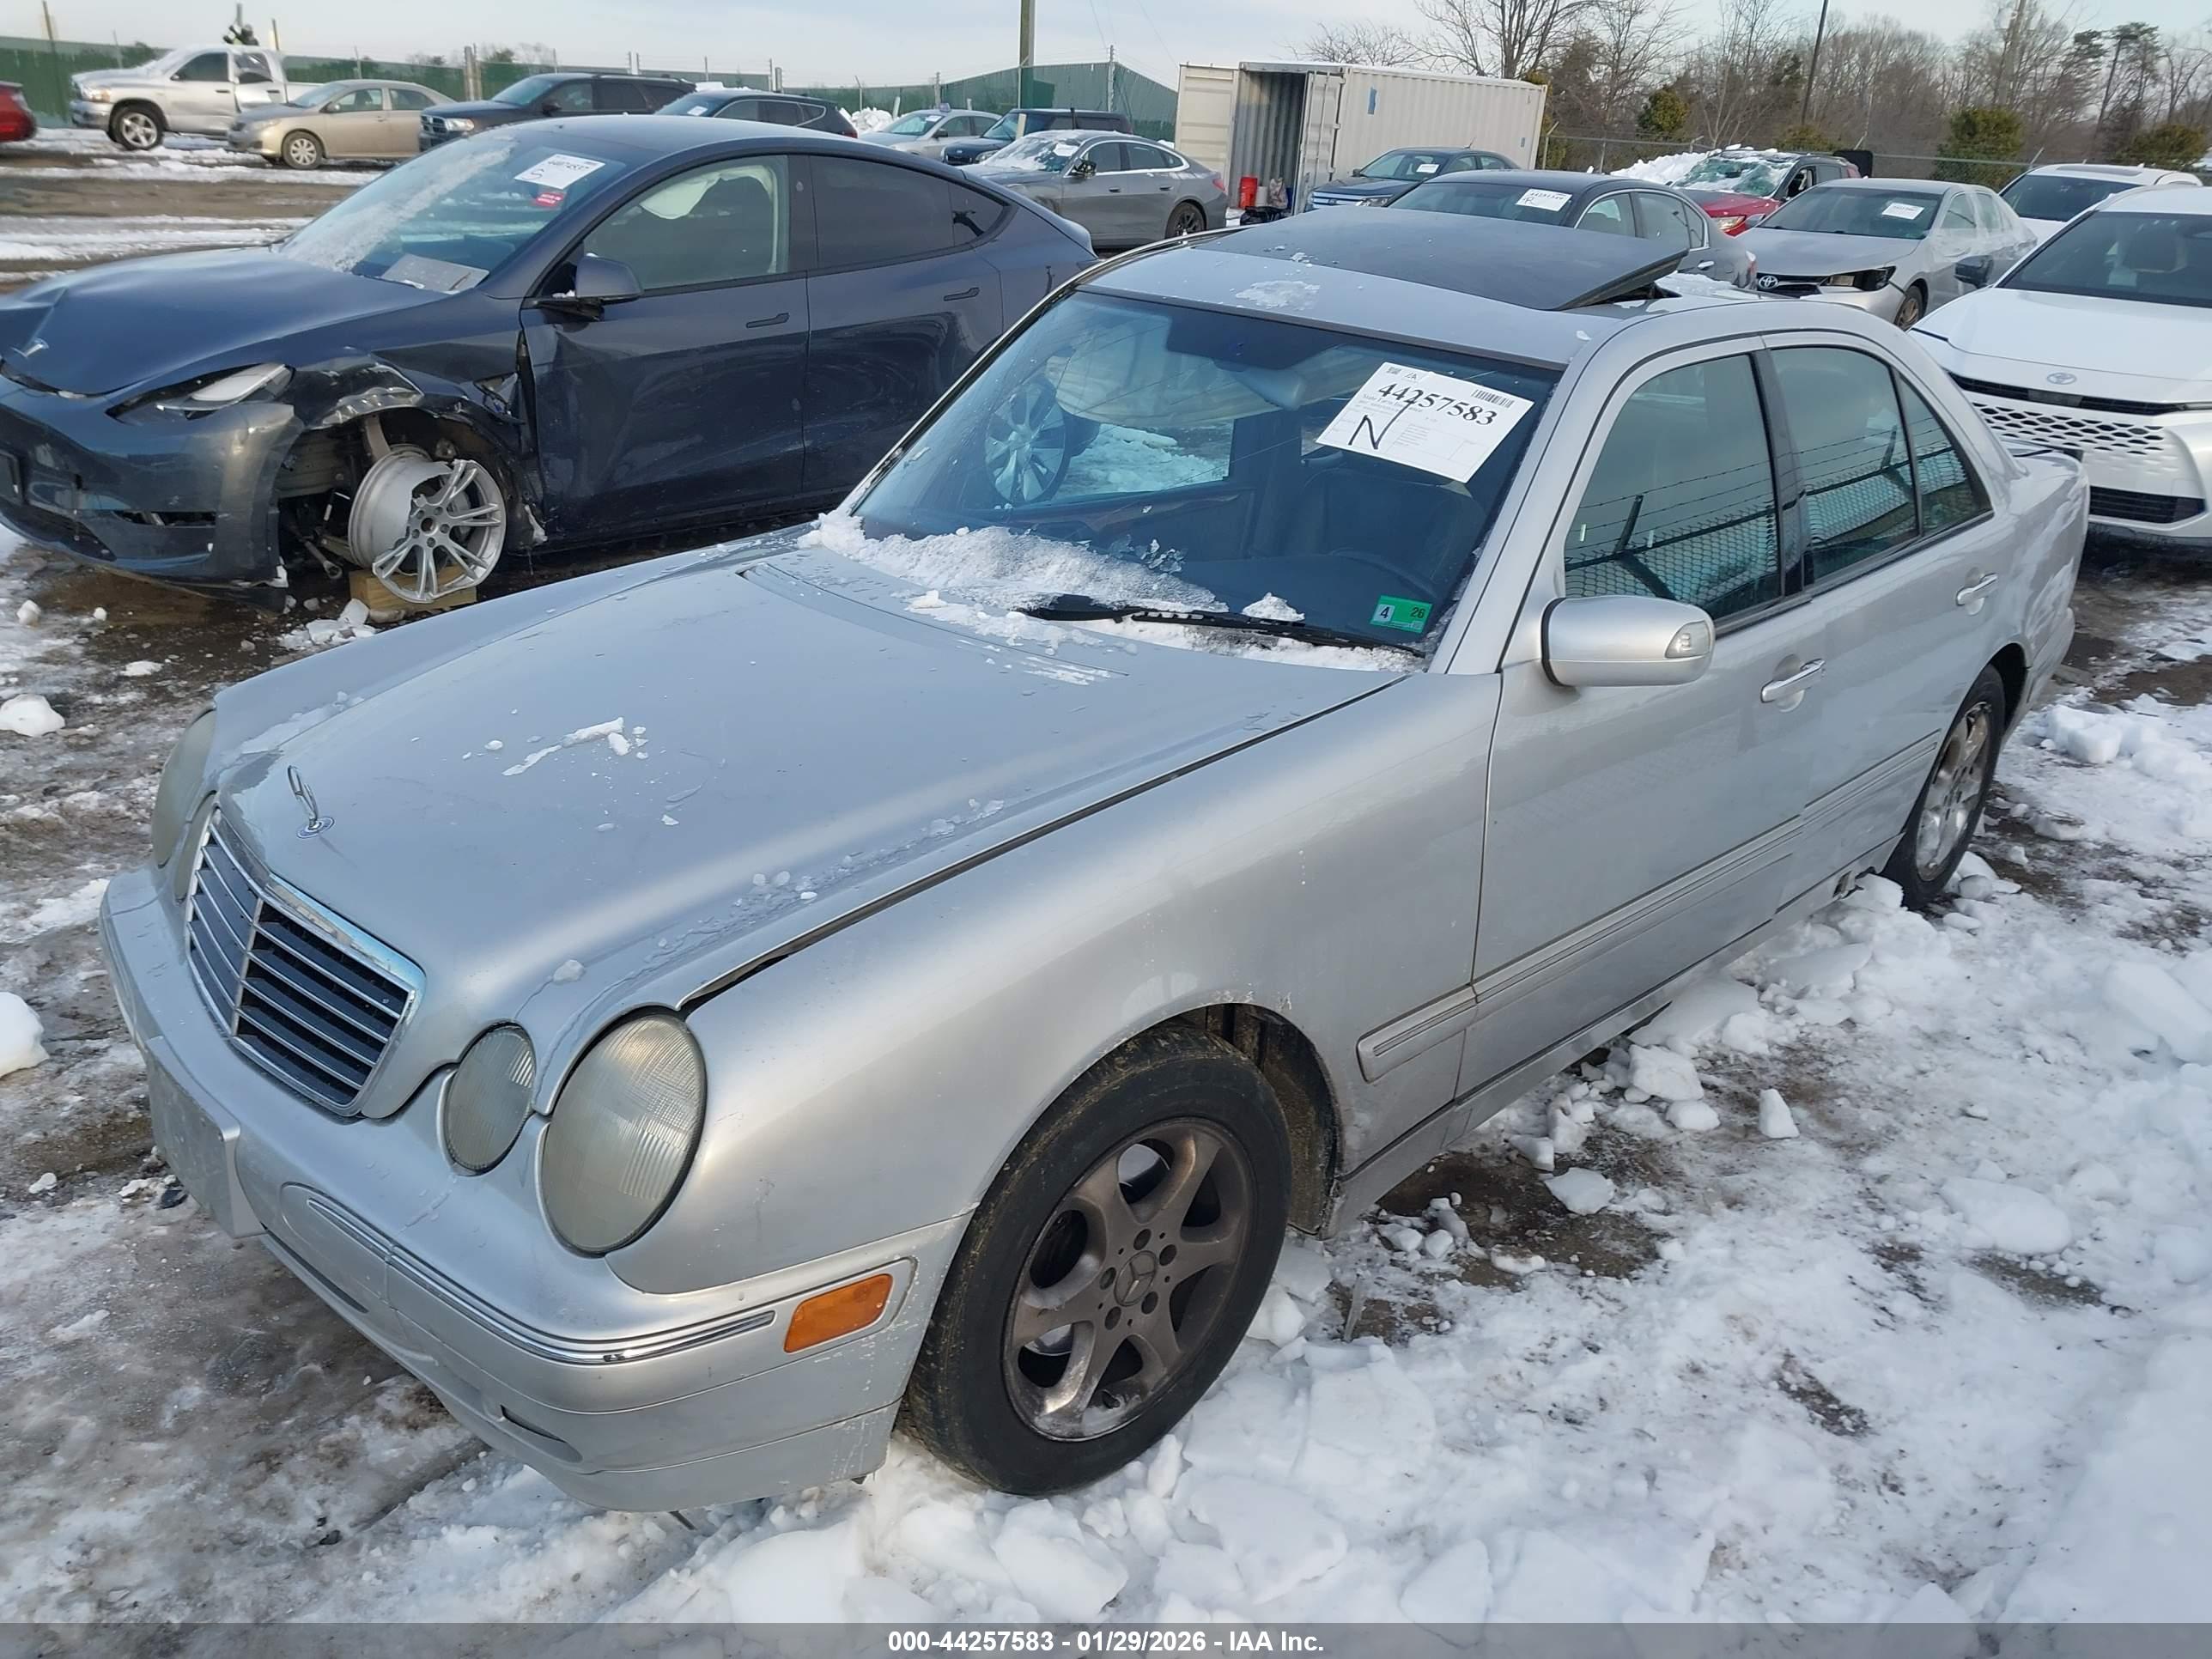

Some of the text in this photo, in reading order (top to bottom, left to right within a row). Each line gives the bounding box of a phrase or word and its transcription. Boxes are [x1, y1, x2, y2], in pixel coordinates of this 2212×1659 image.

[1348, 399, 1415, 450] N
[1378, 383, 1498, 426] 44257583
[1380, 606, 1425, 618] 4 26
